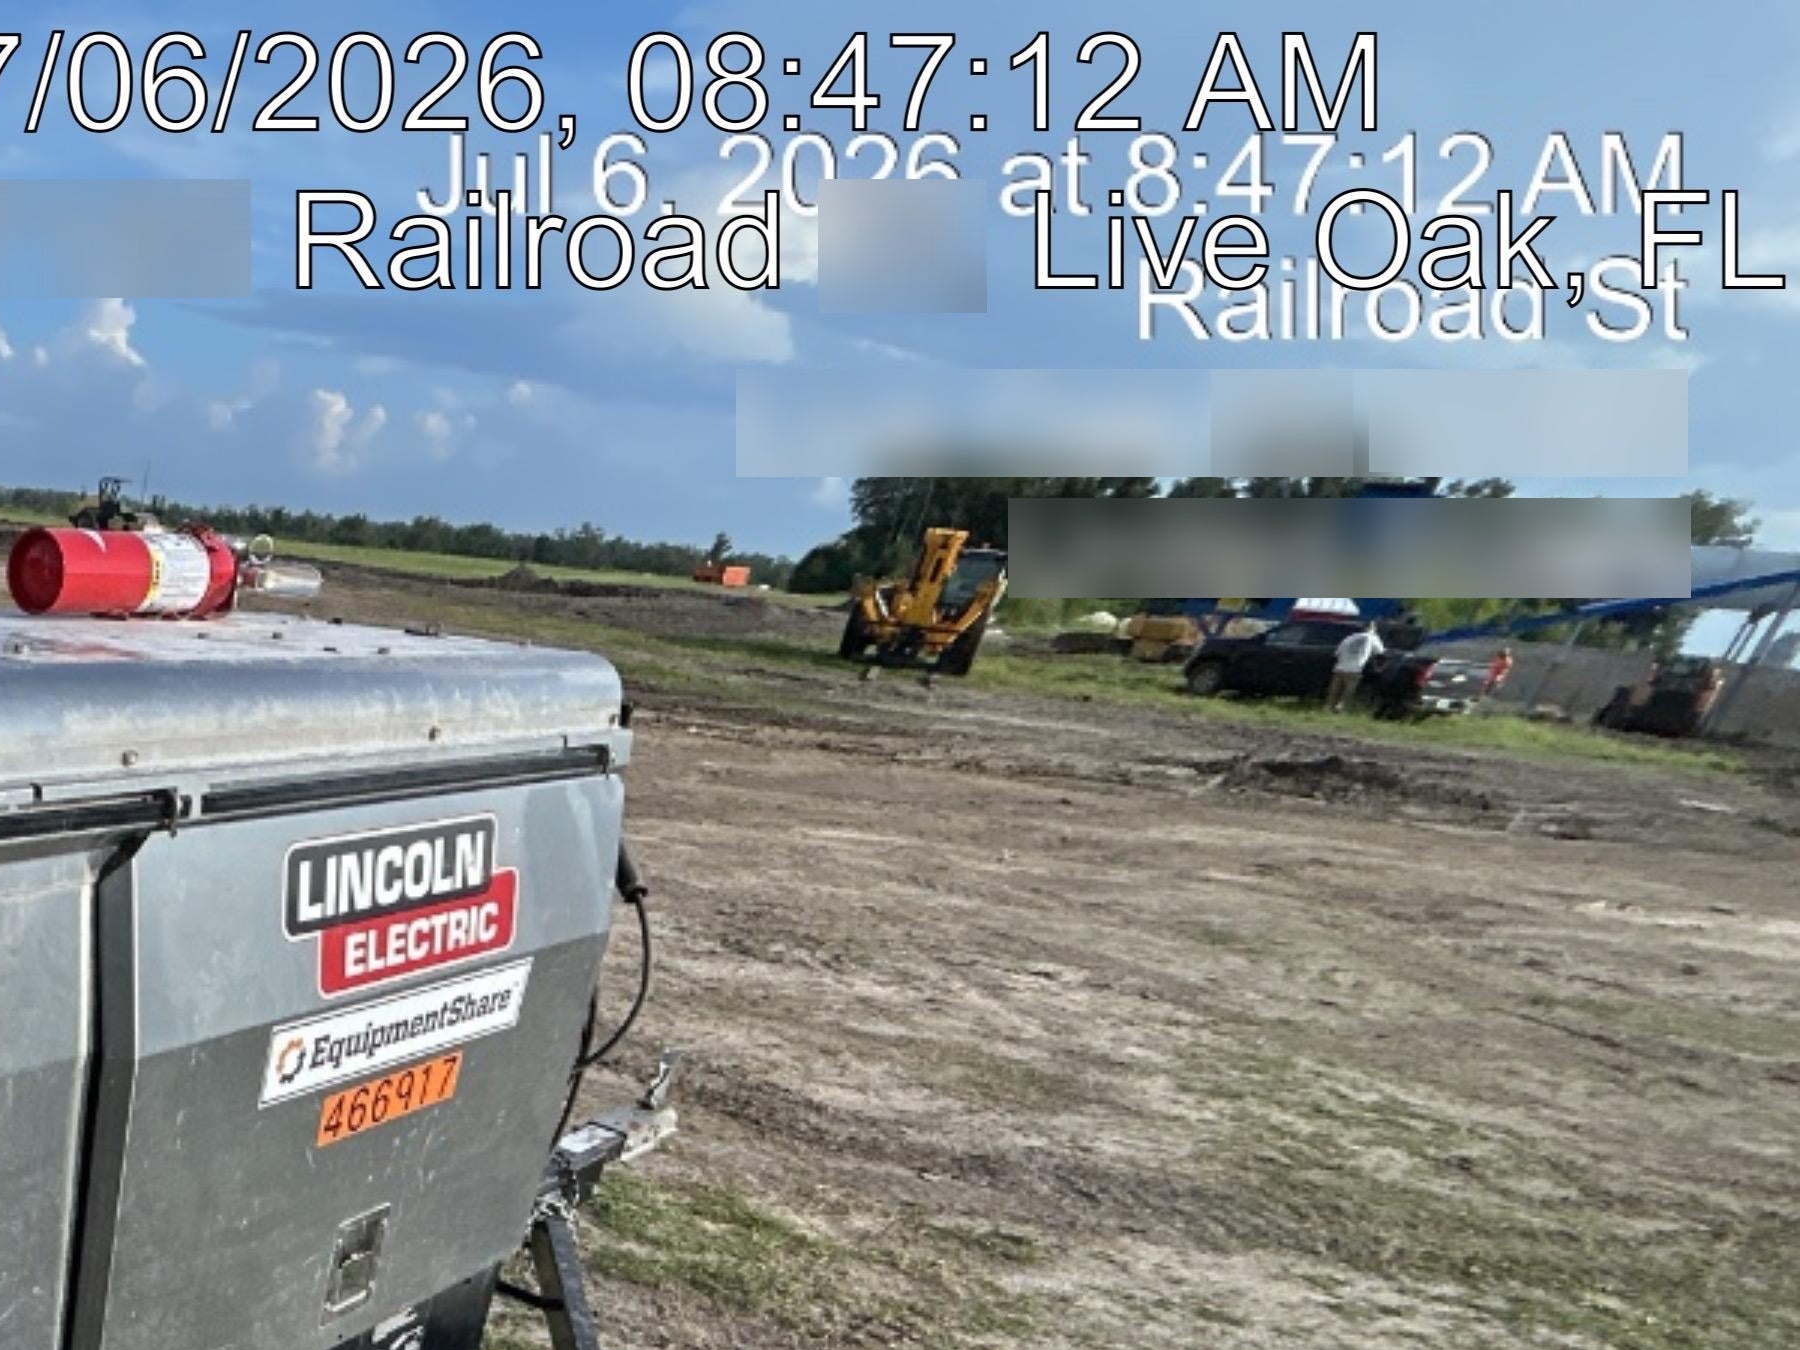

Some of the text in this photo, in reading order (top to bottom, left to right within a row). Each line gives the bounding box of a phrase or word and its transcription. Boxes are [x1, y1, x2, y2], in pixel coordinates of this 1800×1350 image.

[297, 830, 486, 923] LINCOLN
[344, 901, 499, 978] ELECTRIC
[309, 987, 513, 1069] EquipmentShare
[323, 1055, 457, 1137] 466917
